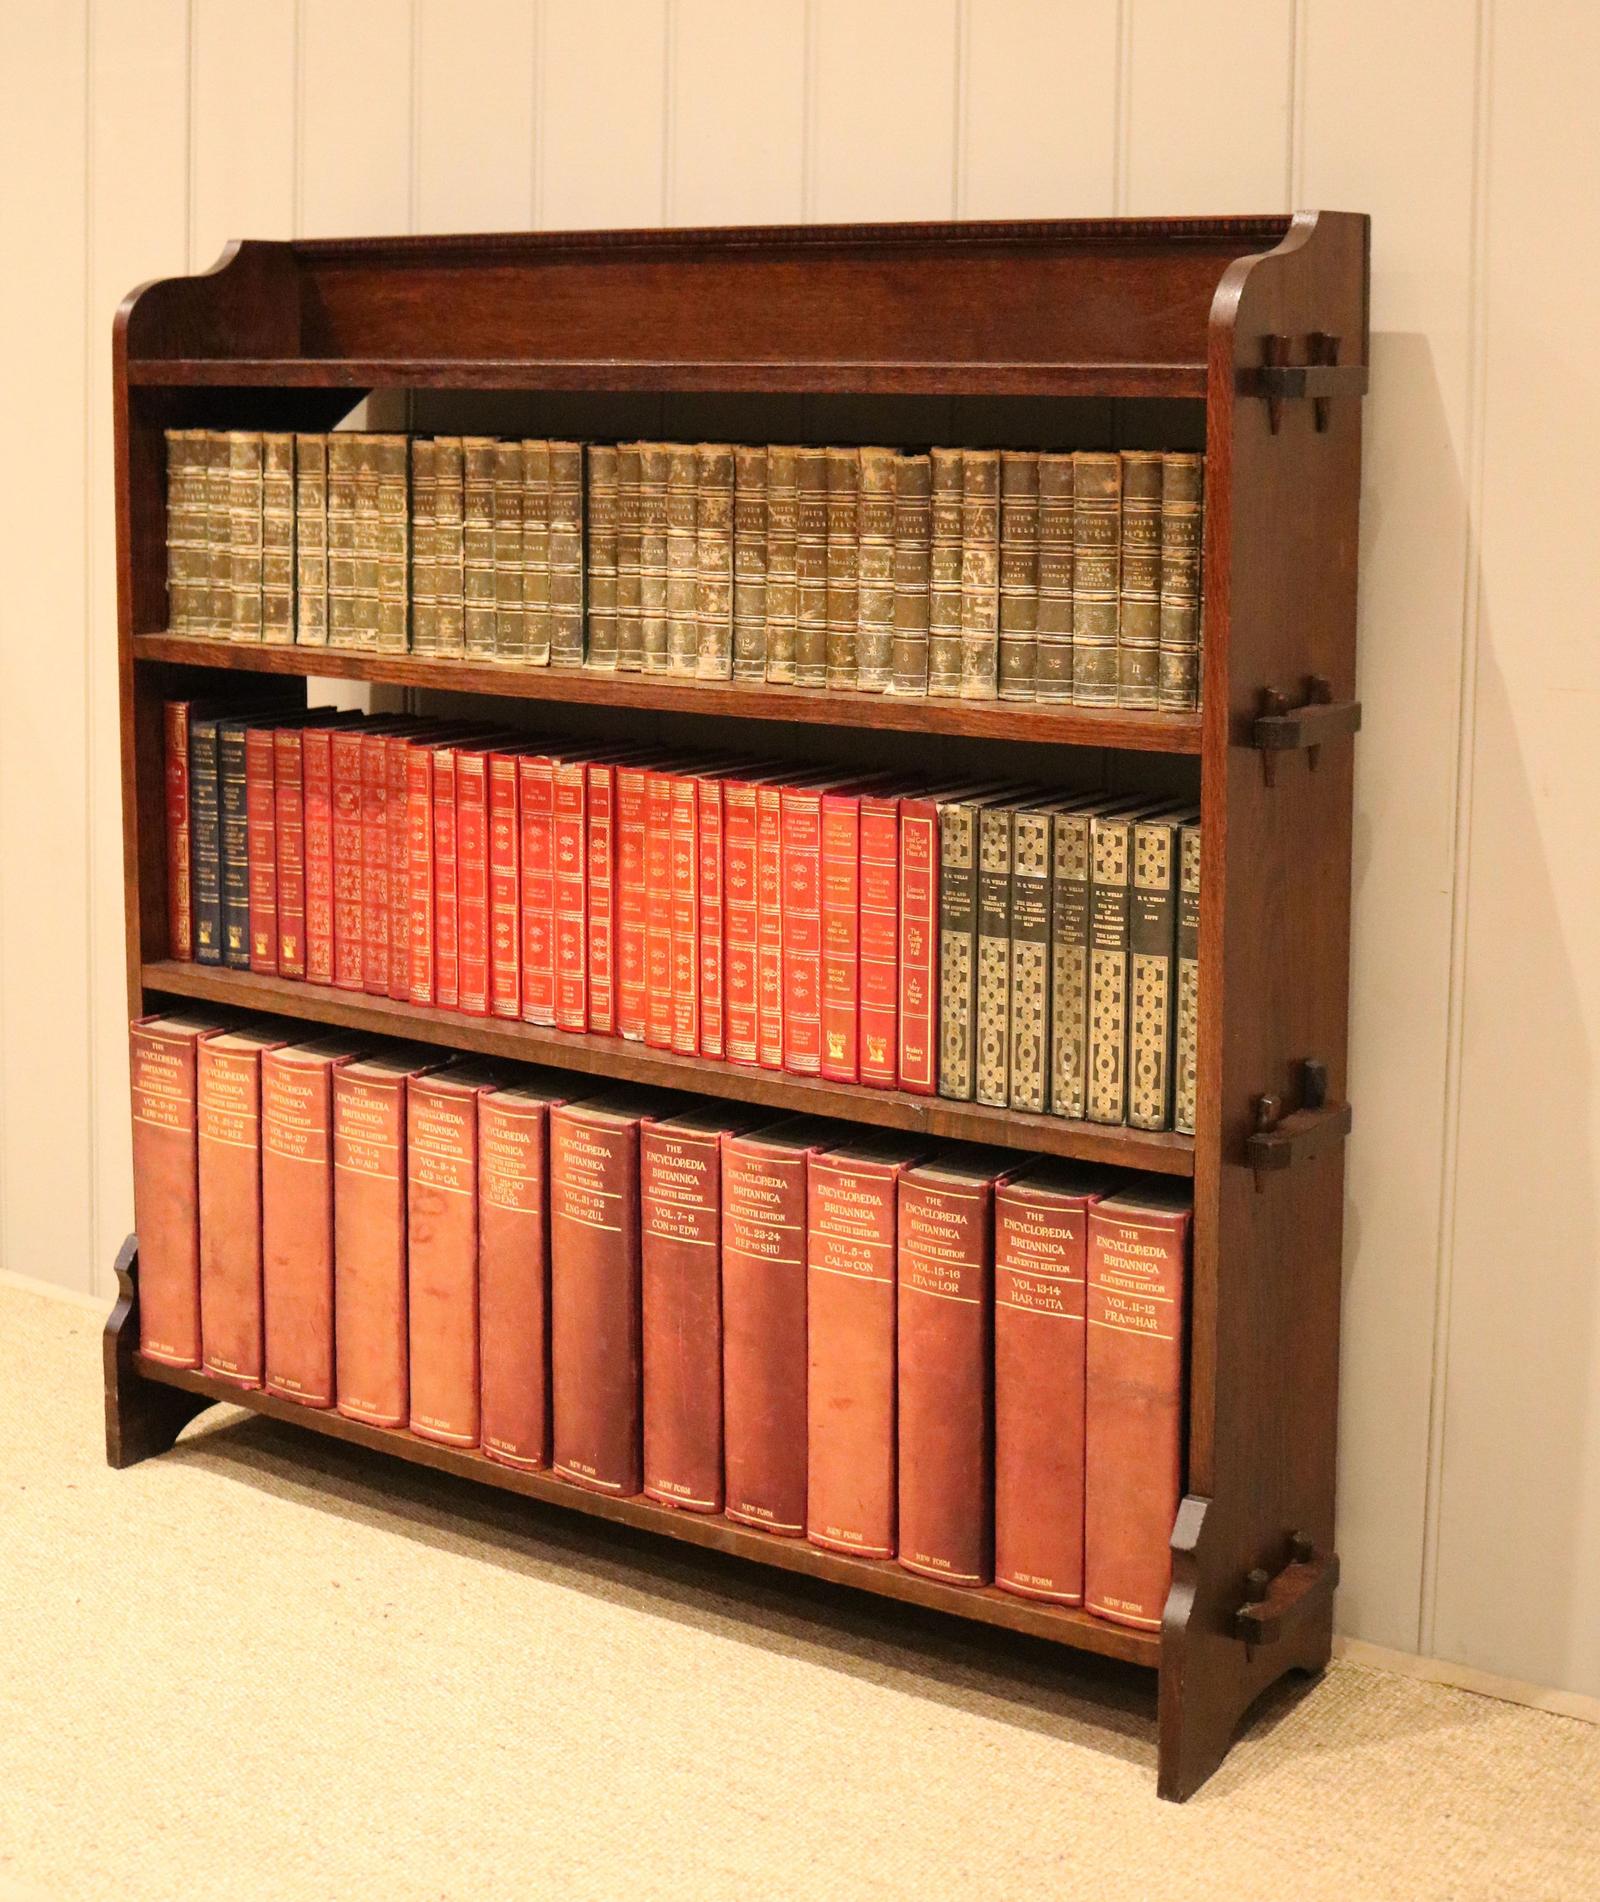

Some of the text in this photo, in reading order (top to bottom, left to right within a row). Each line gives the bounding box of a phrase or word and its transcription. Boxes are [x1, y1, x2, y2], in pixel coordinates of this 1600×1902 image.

[666, 1144, 682, 1153] THE
[746, 1162, 762, 1171] THE
[652, 1168, 699, 1185] BRITANNICA
[839, 1178, 856, 1188] THE
[733, 1184, 781, 1203] BRITANNICA
[925, 1196, 942, 1206] THE
[824, 1202, 875, 1220] BRITANNICA
[1025, 1211, 1045, 1222] THE
[652, 1219, 699, 1236] CON EDW
[911, 1220, 960, 1240] BRITANNICA
[1119, 1229, 1139, 1240] THE
[760, 1243, 780, 1254] SHU
[1010, 1235, 1065, 1255] BRITANNICA
[853, 1261, 874, 1272] CON
[1040, 1262, 1070, 1273] EDITION
[1103, 1253, 1159, 1274] BRITANNICA
[938, 1280, 959, 1293] LOR
[1011, 1290, 1034, 1305] HAR
[1045, 1298, 1064, 1310] ITA
[1136, 1316, 1158, 1330] HAR
